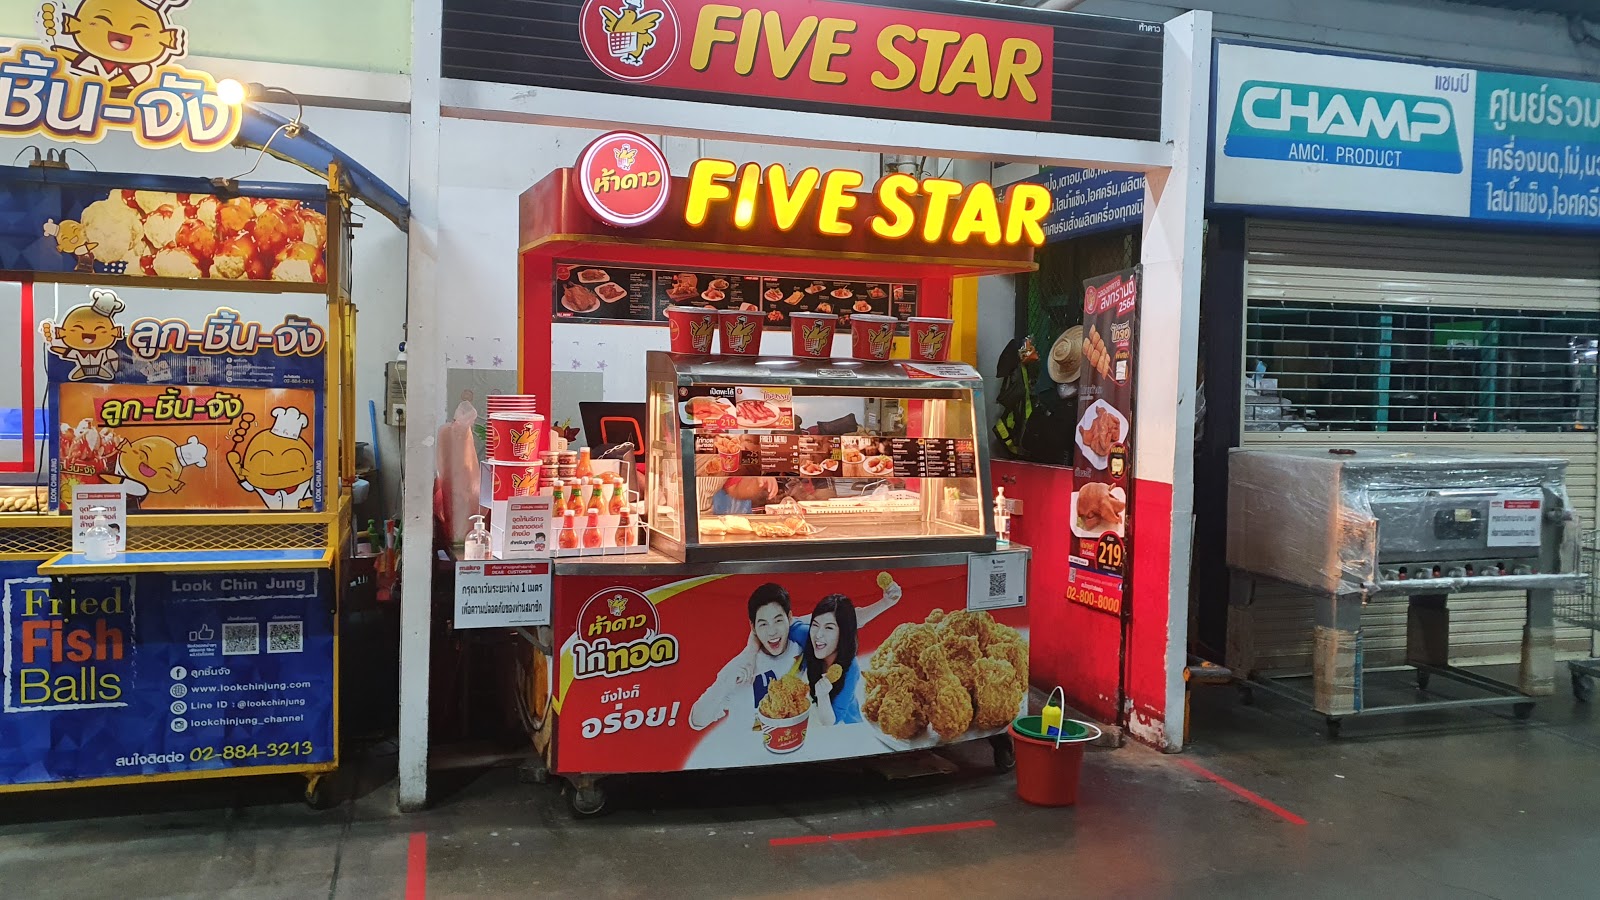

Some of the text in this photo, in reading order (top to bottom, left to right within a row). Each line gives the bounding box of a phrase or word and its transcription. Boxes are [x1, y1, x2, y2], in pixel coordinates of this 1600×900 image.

[689, 4, 1043, 103] FIVE STAR
[1434, 72, 1470, 94] แชมป์
[1241, 86, 1451, 143] CHAMP
[1489, 83, 1600, 131] ศูนย์รวม
[1288, 143, 1402, 168] AMCI. PRODUCT
[592, 167, 661, 195] ห้าดาว
[684, 158, 1053, 247] FIVE STAR
[1100, 274, 1135, 310] สงกรานต์
[131, 310, 322, 358] ลูก-ชิ้น-จัง
[101, 387, 243, 426] ลูก-ชิ้น-จัง
[50, 457, 58, 473] JUNG
[171, 577, 306, 592] Look Chin Jung
[461, 582, 543, 597] กรุณาเว้นระยะห่าง 1 เมตร
[20, 586, 125, 617] Fried
[1066, 585, 1120, 613] 02-800-8000
[587, 614, 647, 637] ห้าดาว
[21, 618, 124, 664] Fish
[574, 636, 676, 675] ไก่ทอด
[19, 666, 122, 704] Balls
[190, 666, 231, 679] ลูกชิ้นจัง
[190, 681, 311, 693] www.lookchinjung.com
[600, 684, 640, 704] ยังไงก็
[190, 702, 213, 710] Line
[216, 700, 228, 709] ID
[237, 698, 306, 710] @lookchinjung
[190, 714, 304, 727] lookchinjung_channel
[581, 702, 681, 740] อร่อย!
[115, 740, 313, 768] สนใจติดต่อ 02-884-3213
